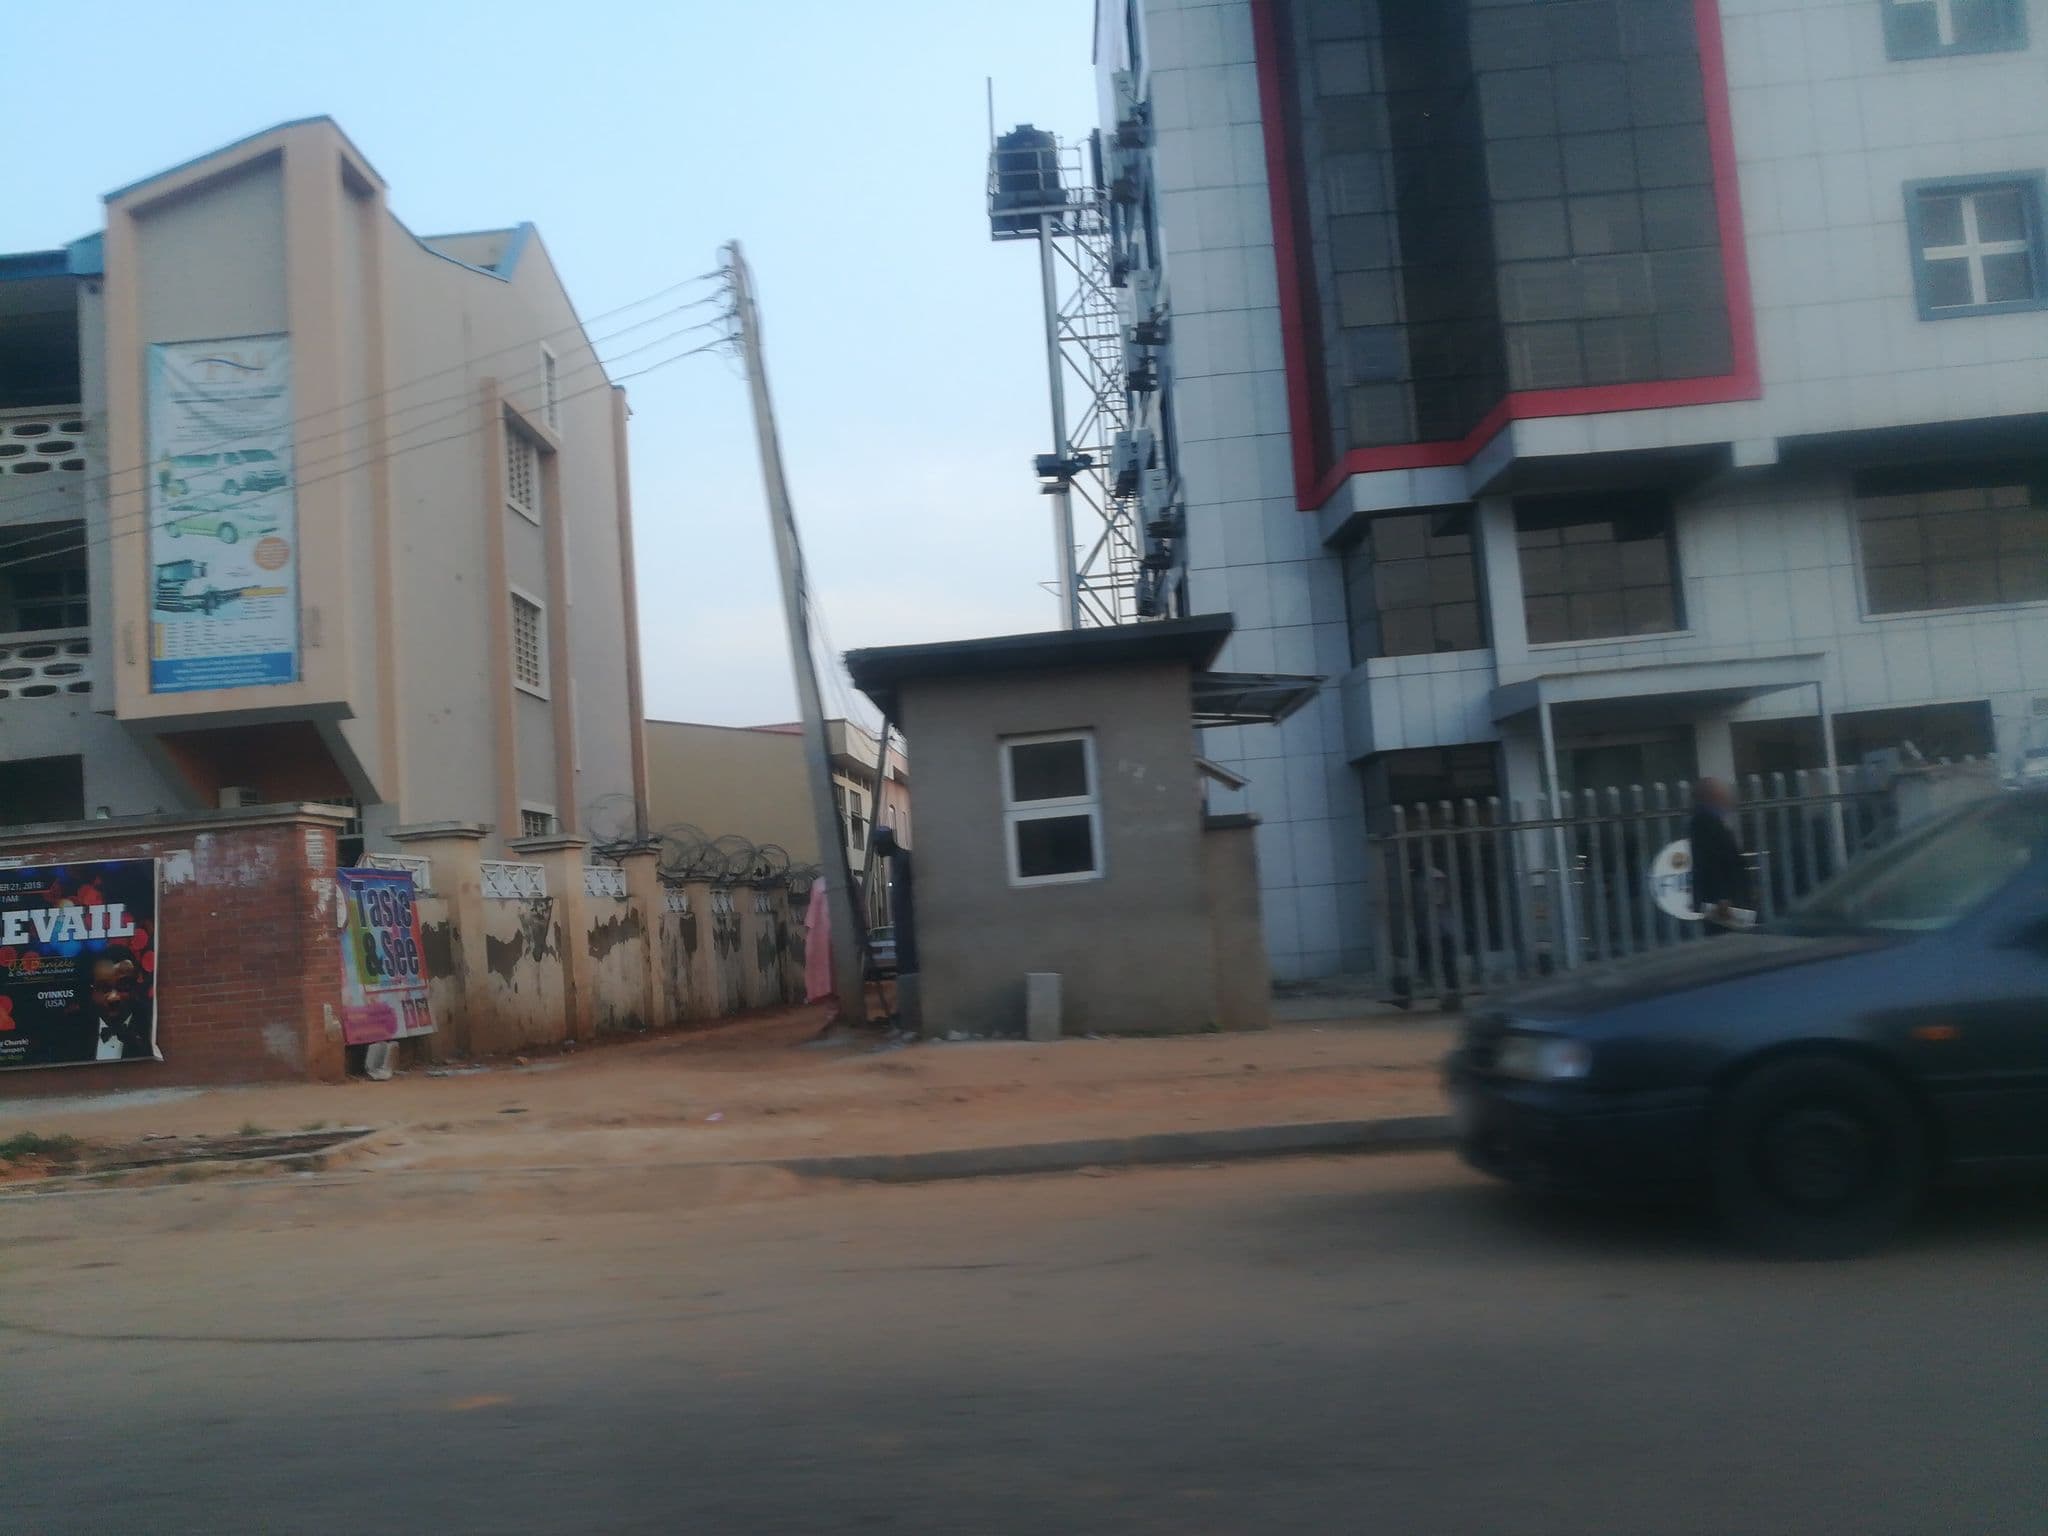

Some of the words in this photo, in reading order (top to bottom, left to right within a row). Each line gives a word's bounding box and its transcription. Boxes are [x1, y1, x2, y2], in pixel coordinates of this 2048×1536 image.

[0, 903, 136, 945] EVAIL
[350, 880, 413, 929] Taste
[45, 999, 66, 1009] (USA)
